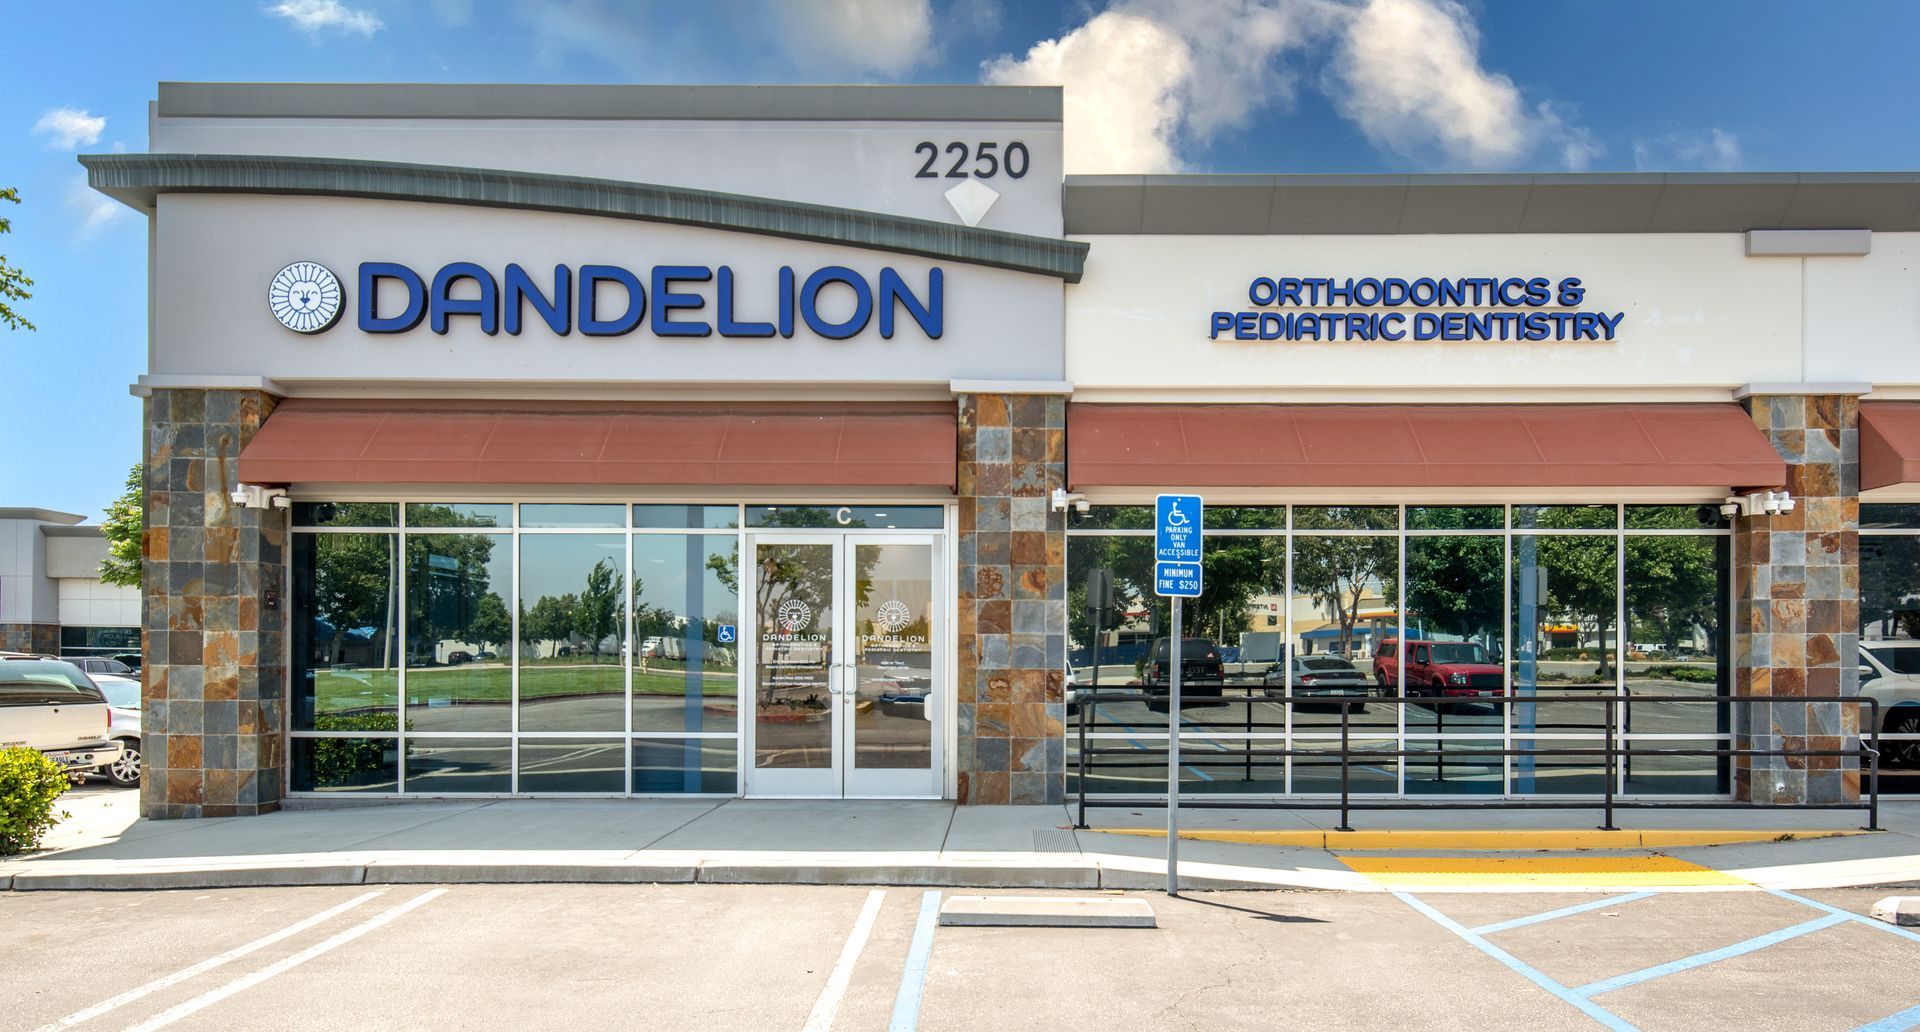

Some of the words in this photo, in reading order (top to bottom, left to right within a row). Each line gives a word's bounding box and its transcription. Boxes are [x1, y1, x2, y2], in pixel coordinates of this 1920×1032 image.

[913, 141, 1031, 179] 2250
[1249, 276, 1552, 307] ORTHODONTICS
[1557, 277, 1587, 307] &
[358, 261, 944, 340] DANDELION
[1210, 311, 1407, 341] PEDIATRIC
[1413, 311, 1625, 342] DENTISTRY
[836, 506, 852, 525] C
[1165, 526, 1193, 534] PARKING
[1159, 548, 1199, 557] ACCESSIBLE
[1163, 567, 1194, 578] MINIMUM
[1159, 579, 1174, 589] FINE
[1178, 580, 1198, 590] $250
[762, 633, 827, 641] DANDELION
[861, 634, 926, 643] DANDELION
